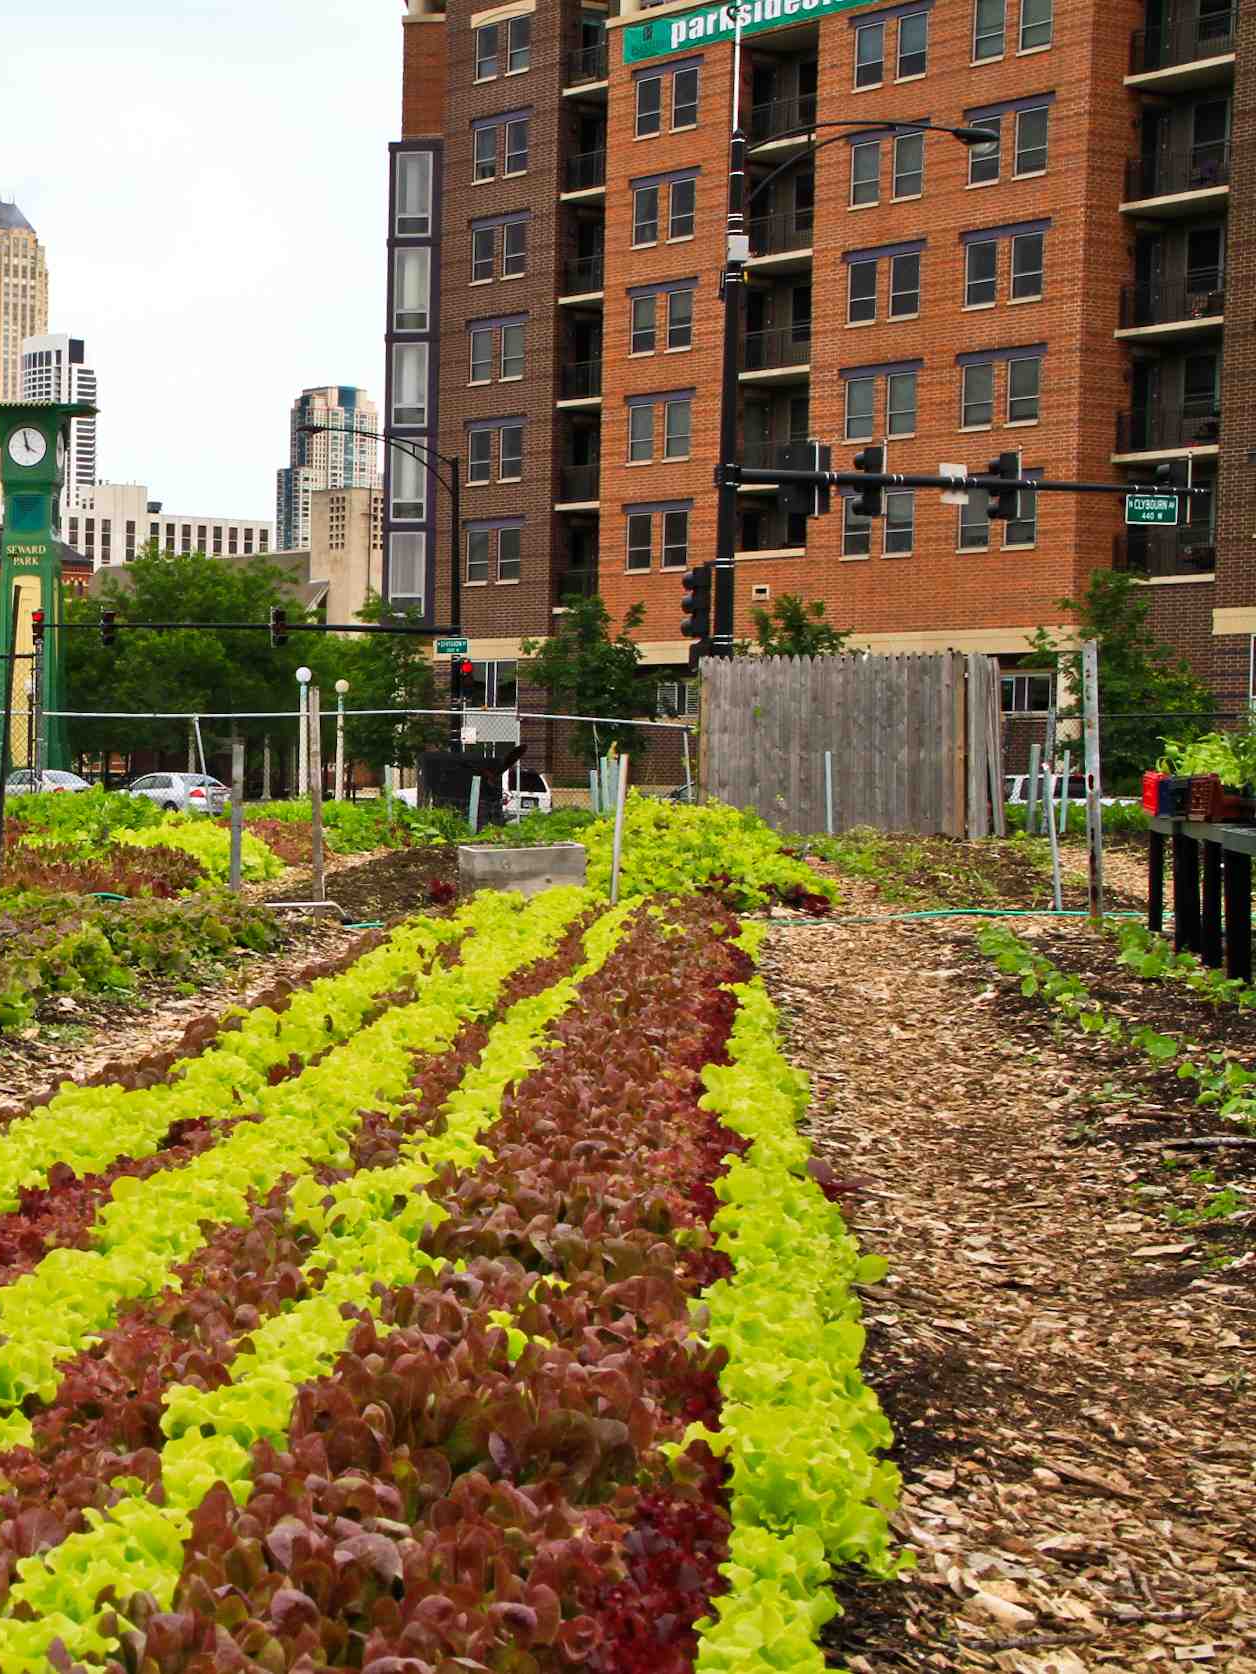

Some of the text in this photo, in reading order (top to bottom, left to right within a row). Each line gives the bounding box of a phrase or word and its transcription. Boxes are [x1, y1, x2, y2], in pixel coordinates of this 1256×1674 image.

[1134, 499, 1168, 510] CLYBOURN
[6, 544, 46, 554] SEWARD
[13, 556, 39, 566] PARK
